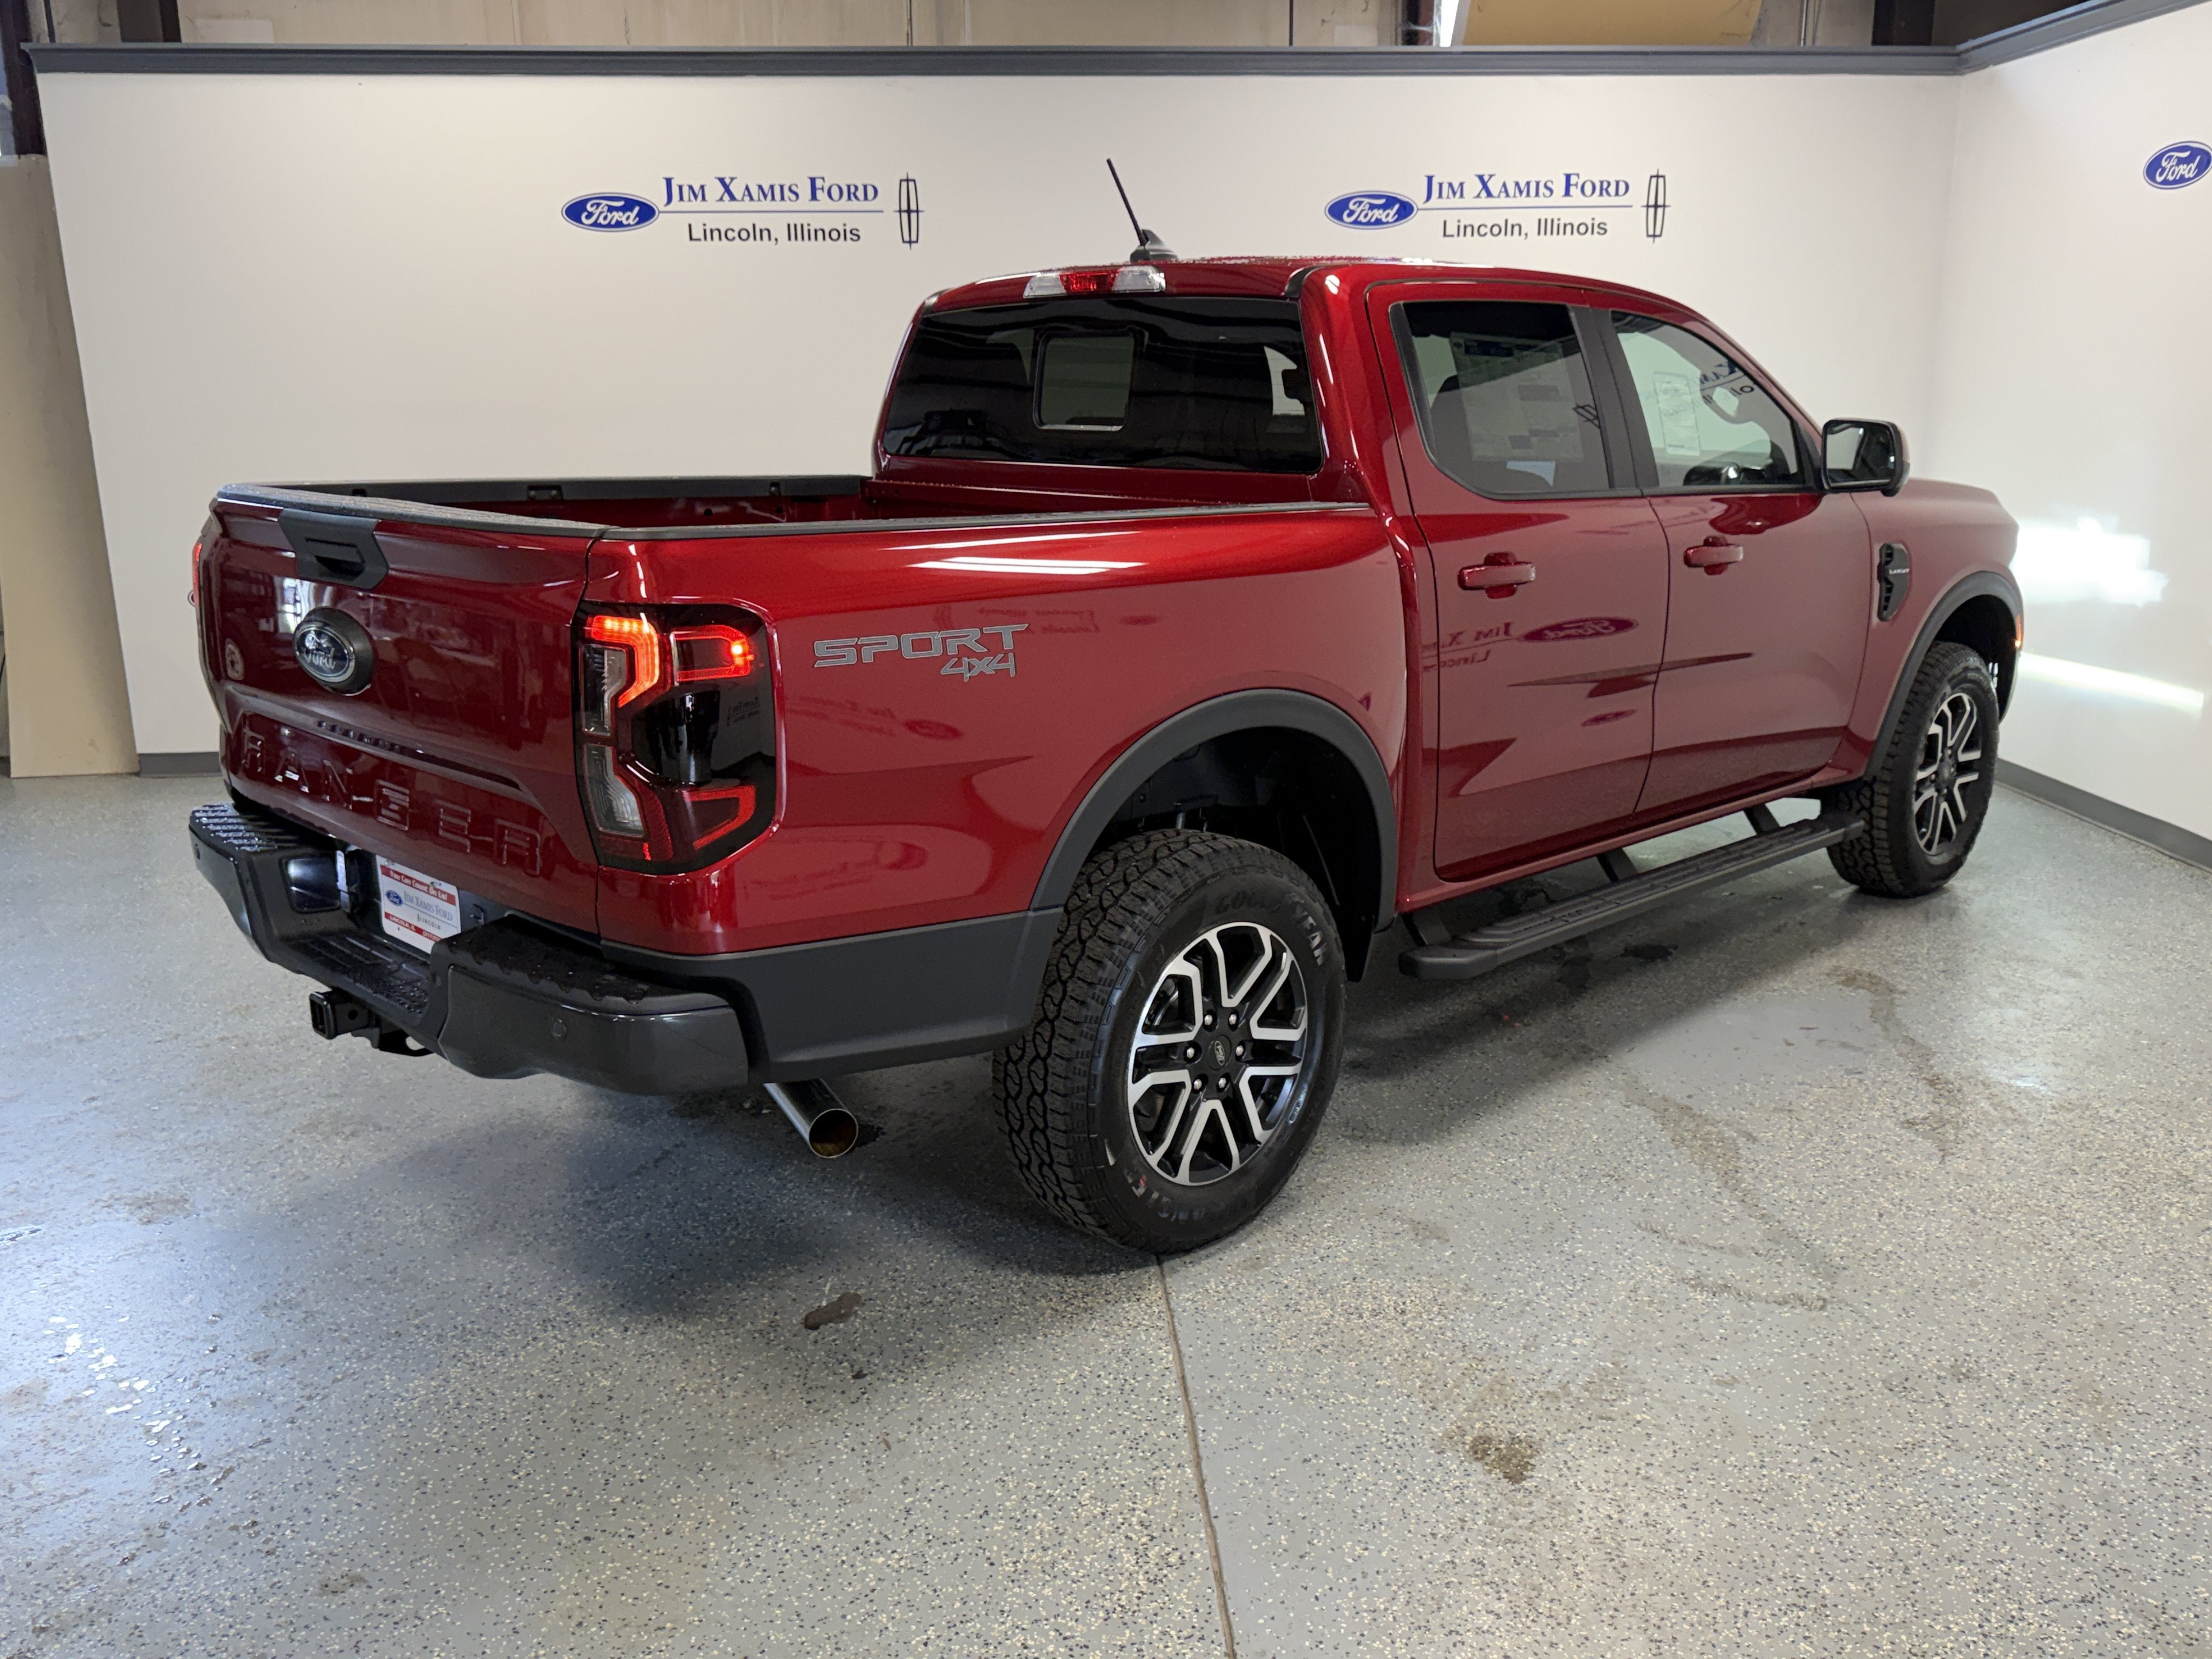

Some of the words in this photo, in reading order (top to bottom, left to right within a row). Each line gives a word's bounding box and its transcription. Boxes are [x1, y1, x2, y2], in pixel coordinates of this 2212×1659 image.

[2155, 150, 2201, 183] Ford
[662, 177, 707, 207] JIM
[714, 177, 799, 202] XAMIS
[807, 177, 878, 202] FORD
[1423, 174, 1465, 204] JIM
[1473, 173, 1554, 200] XAMIS
[1561, 173, 1629, 198] FORD
[580, 199, 639, 225] Ford
[1342, 197, 1398, 224] Ford
[688, 223, 779, 245] Lincoln,
[787, 223, 861, 242] Illinois
[1442, 219, 1528, 240] Lincoln,
[1537, 218, 1607, 237] Illinois
[302, 632, 336, 669] Ford
[812, 623, 1030, 668] SPORT
[242, 724, 541, 876] RANGER
[390, 870, 400, 880] You
[401, 875, 411, 885] Can
[412, 879, 429, 893] Count
